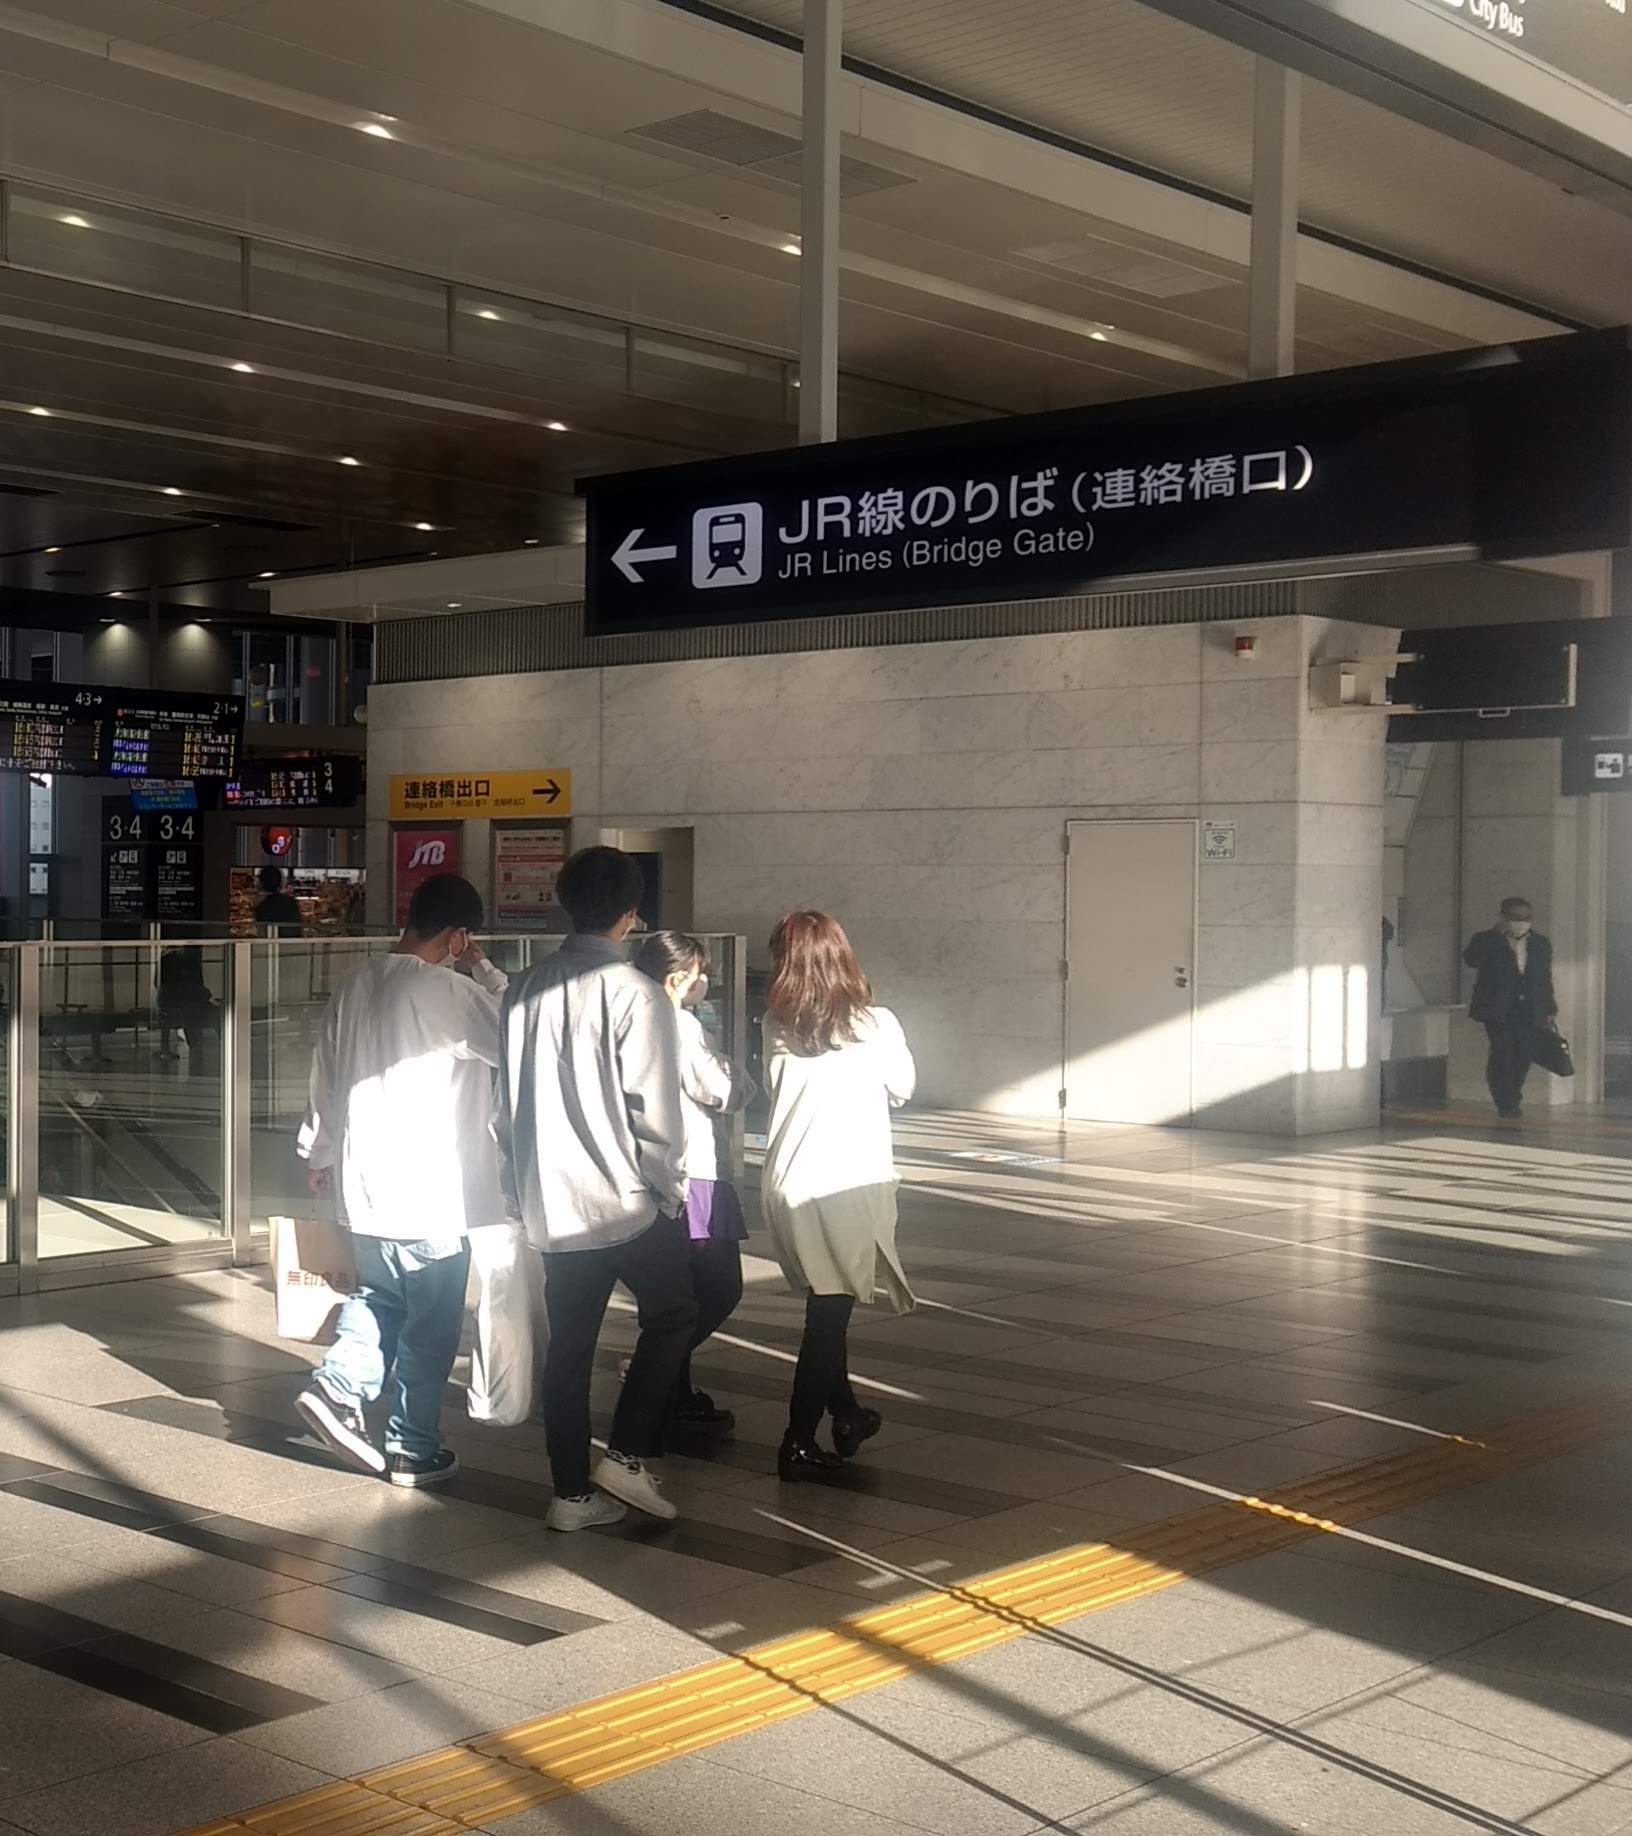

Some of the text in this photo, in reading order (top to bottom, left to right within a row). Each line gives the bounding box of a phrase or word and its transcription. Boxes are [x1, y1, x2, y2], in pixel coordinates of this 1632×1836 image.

[1499, 1, 1524, 37] Bus
[778, 521, 1096, 579] JR Lines (Bridge Gate)
[404, 779, 490, 799] 連絡橋出口
[404, 801, 427, 811] Bridge
[430, 799, 444, 809] Exit
[408, 840, 446, 869] JTB
[1207, 848, 1233, 857] Wi-Fi
[287, 1271, 348, 1289] 無印良品
